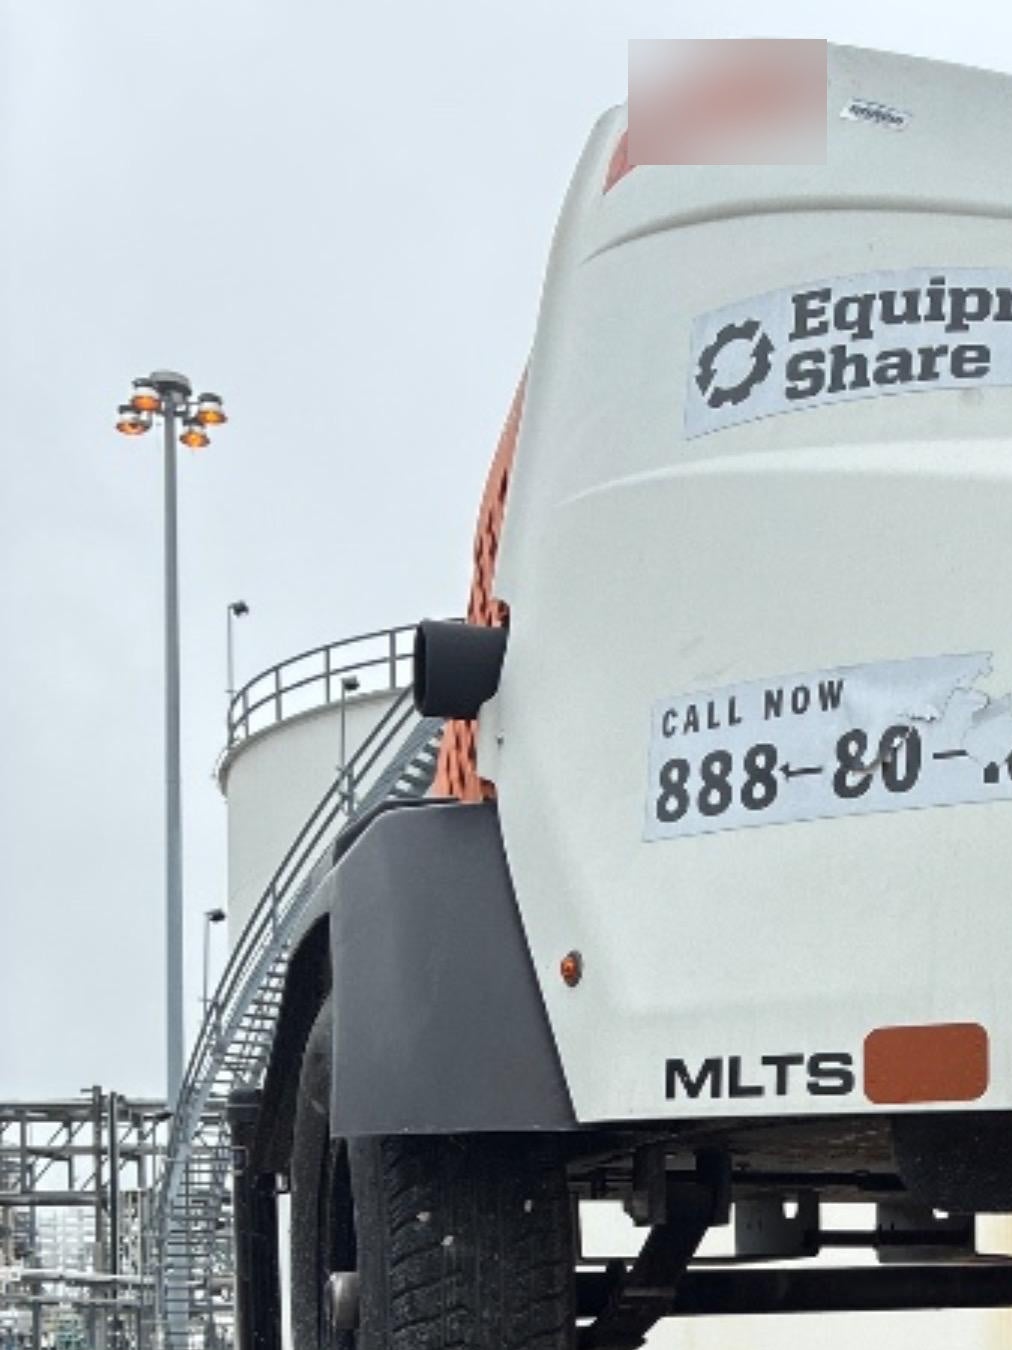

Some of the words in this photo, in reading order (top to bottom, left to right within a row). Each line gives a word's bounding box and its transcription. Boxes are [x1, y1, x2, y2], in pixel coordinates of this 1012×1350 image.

[785, 343, 991, 400] Share
[662, 697, 742, 739] CALL
[763, 679, 845, 720] NOW
[665, 1052, 855, 1100] MLTS
